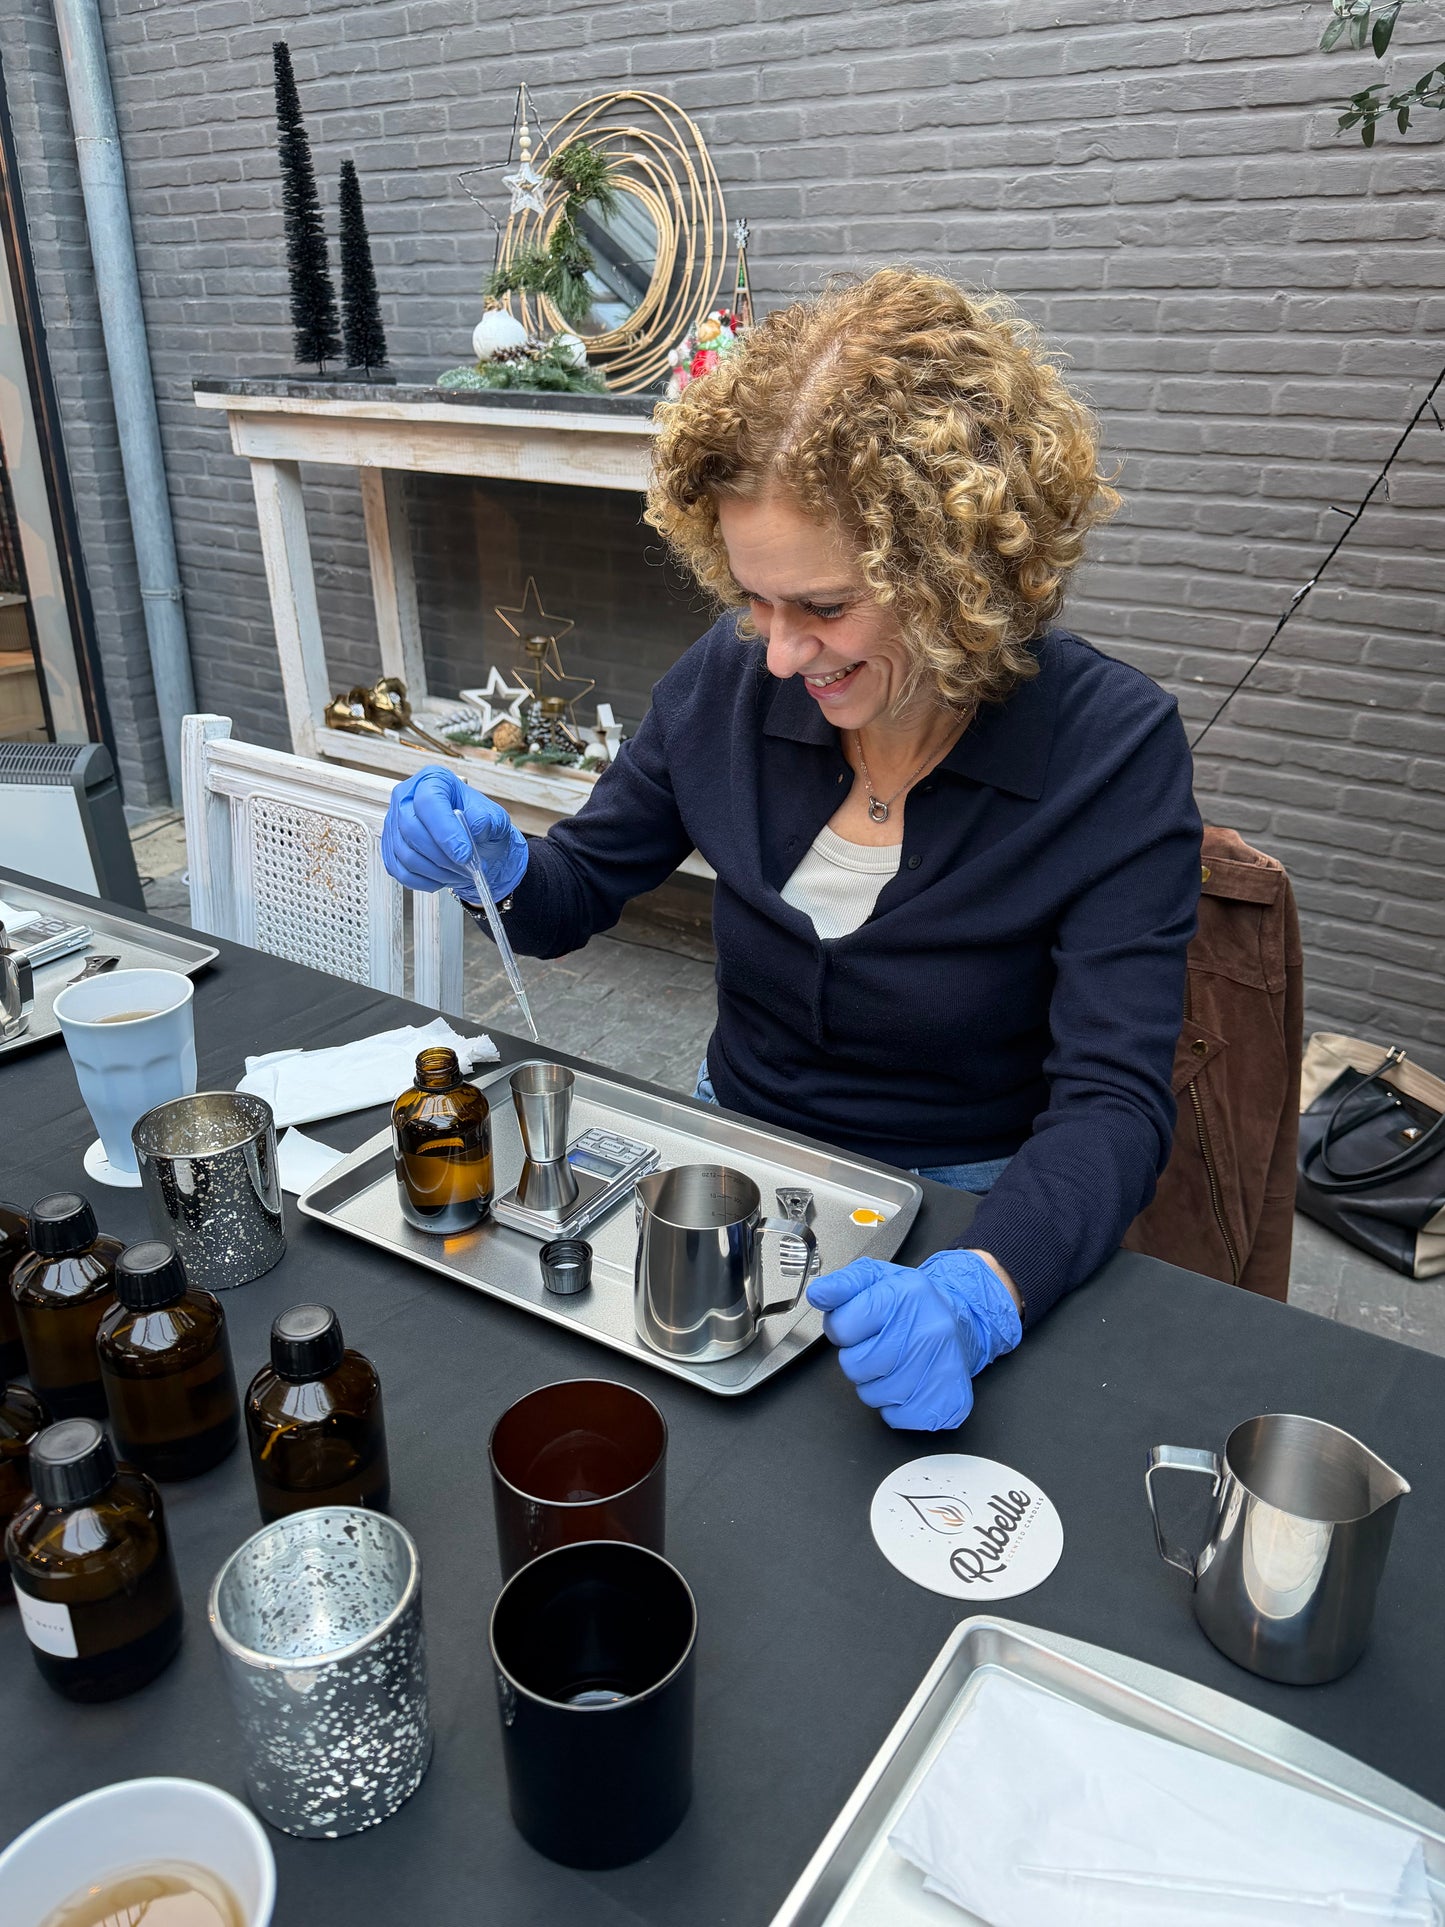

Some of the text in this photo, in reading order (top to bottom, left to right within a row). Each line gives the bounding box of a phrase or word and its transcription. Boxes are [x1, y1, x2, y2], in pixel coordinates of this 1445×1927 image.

[950, 1490, 1031, 1583] Rubelle
[1006, 1497, 1044, 1562] SCENTED CANDLES
